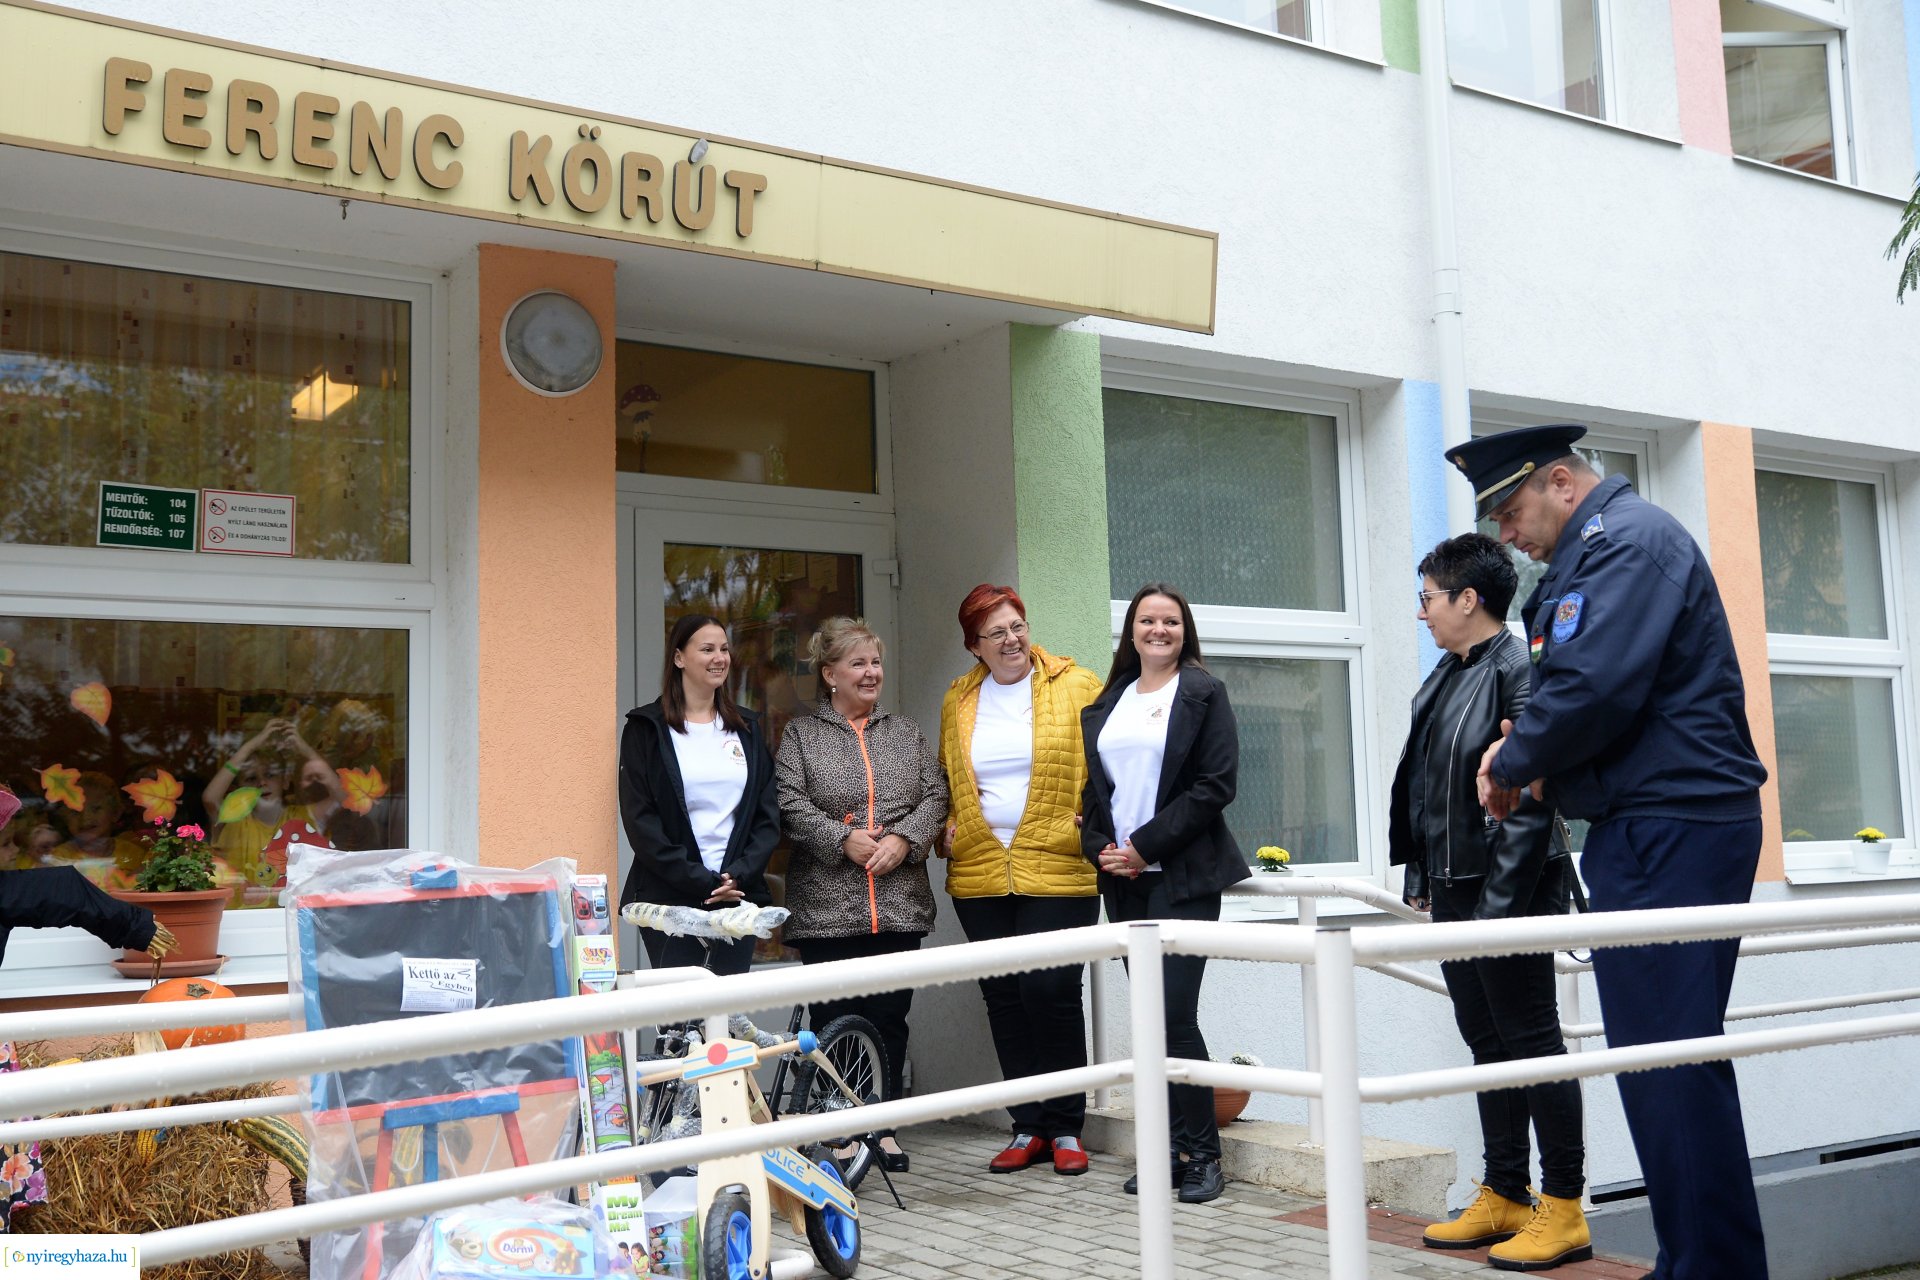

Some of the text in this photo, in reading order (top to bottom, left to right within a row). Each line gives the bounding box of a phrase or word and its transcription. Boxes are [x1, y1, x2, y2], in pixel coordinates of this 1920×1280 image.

[102, 56, 768, 238] FERENC KÖRÚT
[105, 492, 187, 509] MENTŐK: 104
[105, 506, 186, 524] TŰZOLTÓK: 105
[238, 504, 257, 515] ÉPÜLET
[258, 507, 286, 515] TERÜLETÉN
[104, 523, 186, 539] RENDŐRSÉG: 107
[240, 532, 270, 541] DOHÁNYZÁS
[443, 972, 457, 980] az
[438, 980, 473, 992] Egyben
[607, 1196, 638, 1209] My
[607, 1210, 642, 1221] Dream
[609, 1221, 631, 1233] Mat
